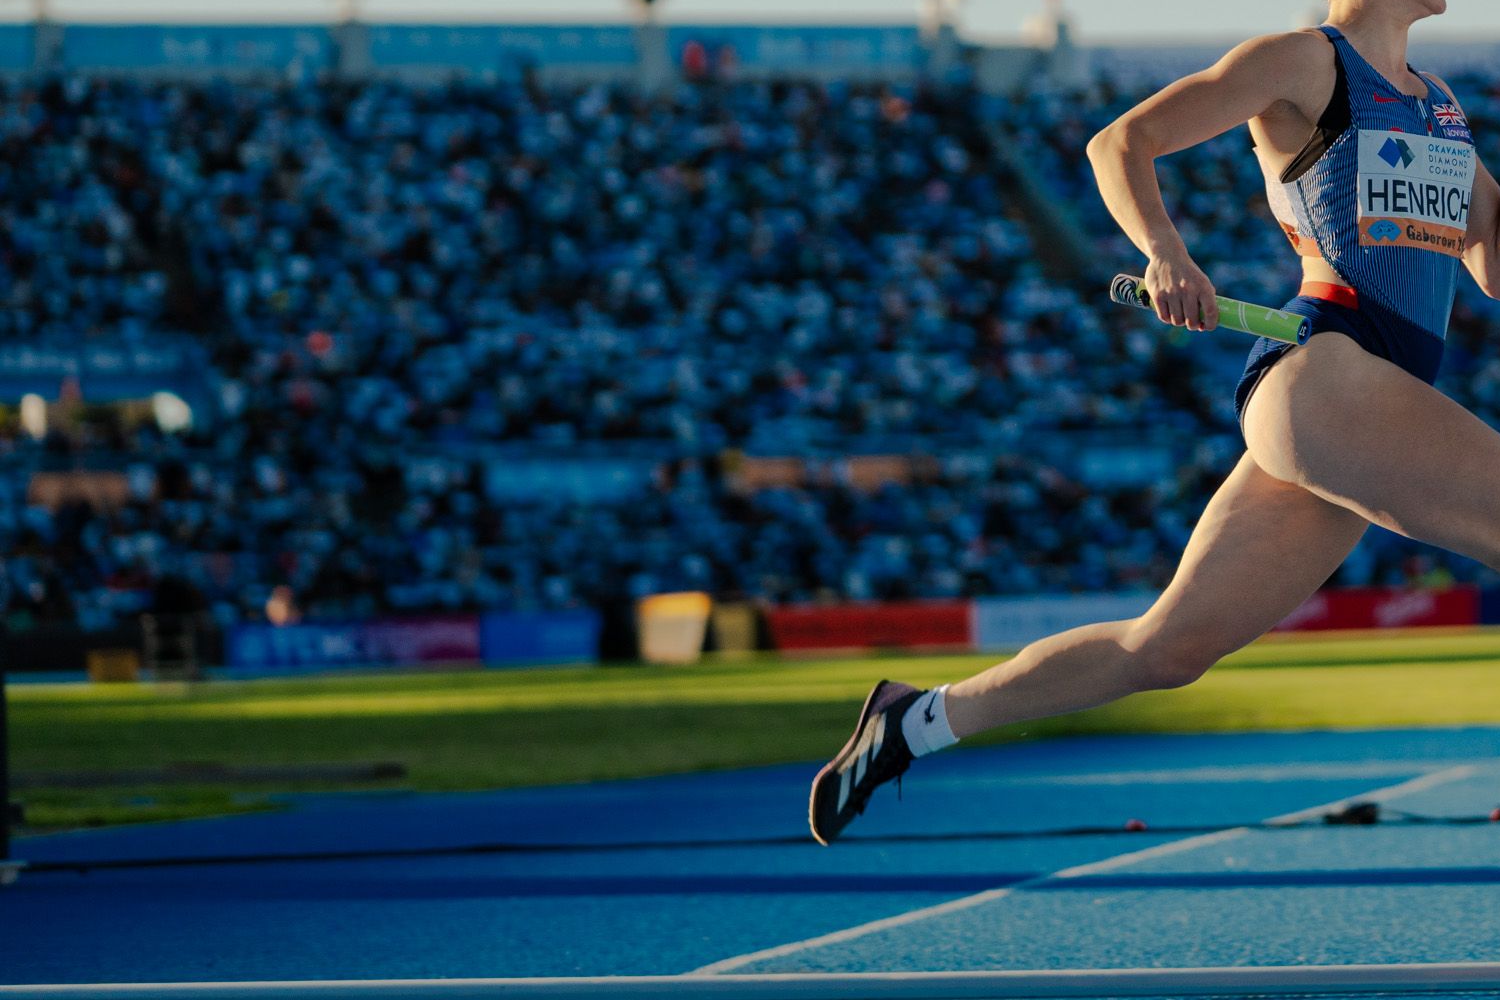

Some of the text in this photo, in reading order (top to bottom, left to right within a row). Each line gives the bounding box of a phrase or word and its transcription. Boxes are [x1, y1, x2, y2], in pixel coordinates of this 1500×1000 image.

[1428, 143, 1471, 159] OKAVANGO
[1428, 154, 1468, 169] DIAMOND
[1428, 165, 1467, 180] COMPANY
[1367, 178, 1470, 224] HENRICH
